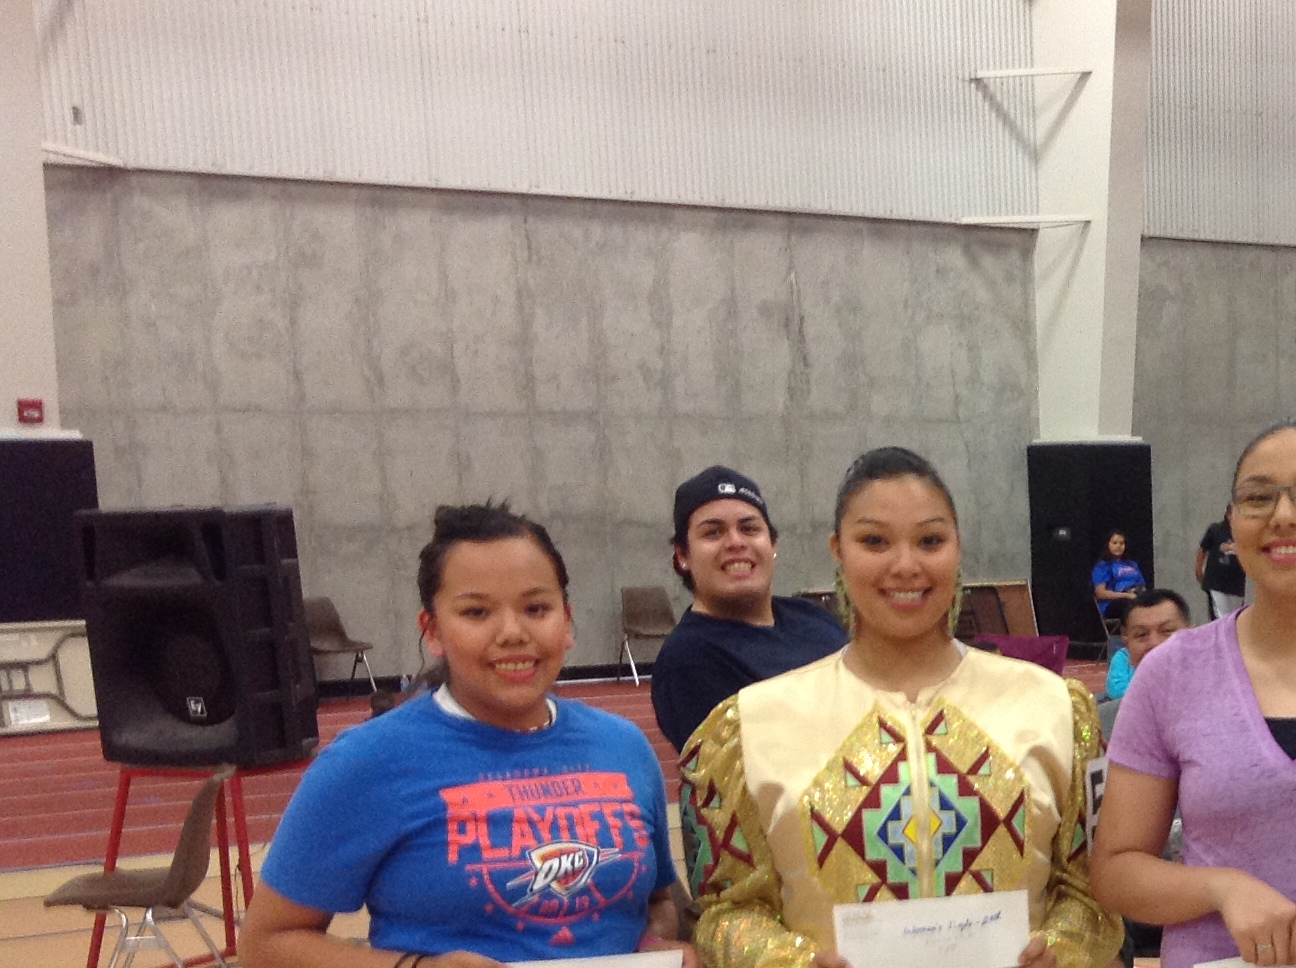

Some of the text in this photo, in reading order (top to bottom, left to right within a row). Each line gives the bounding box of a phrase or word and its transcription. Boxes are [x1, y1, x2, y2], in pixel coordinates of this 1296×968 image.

[506, 778, 584, 803] THUNDER
[447, 802, 650, 865] PLAYOFFS
[531, 850, 585, 892] OKC
